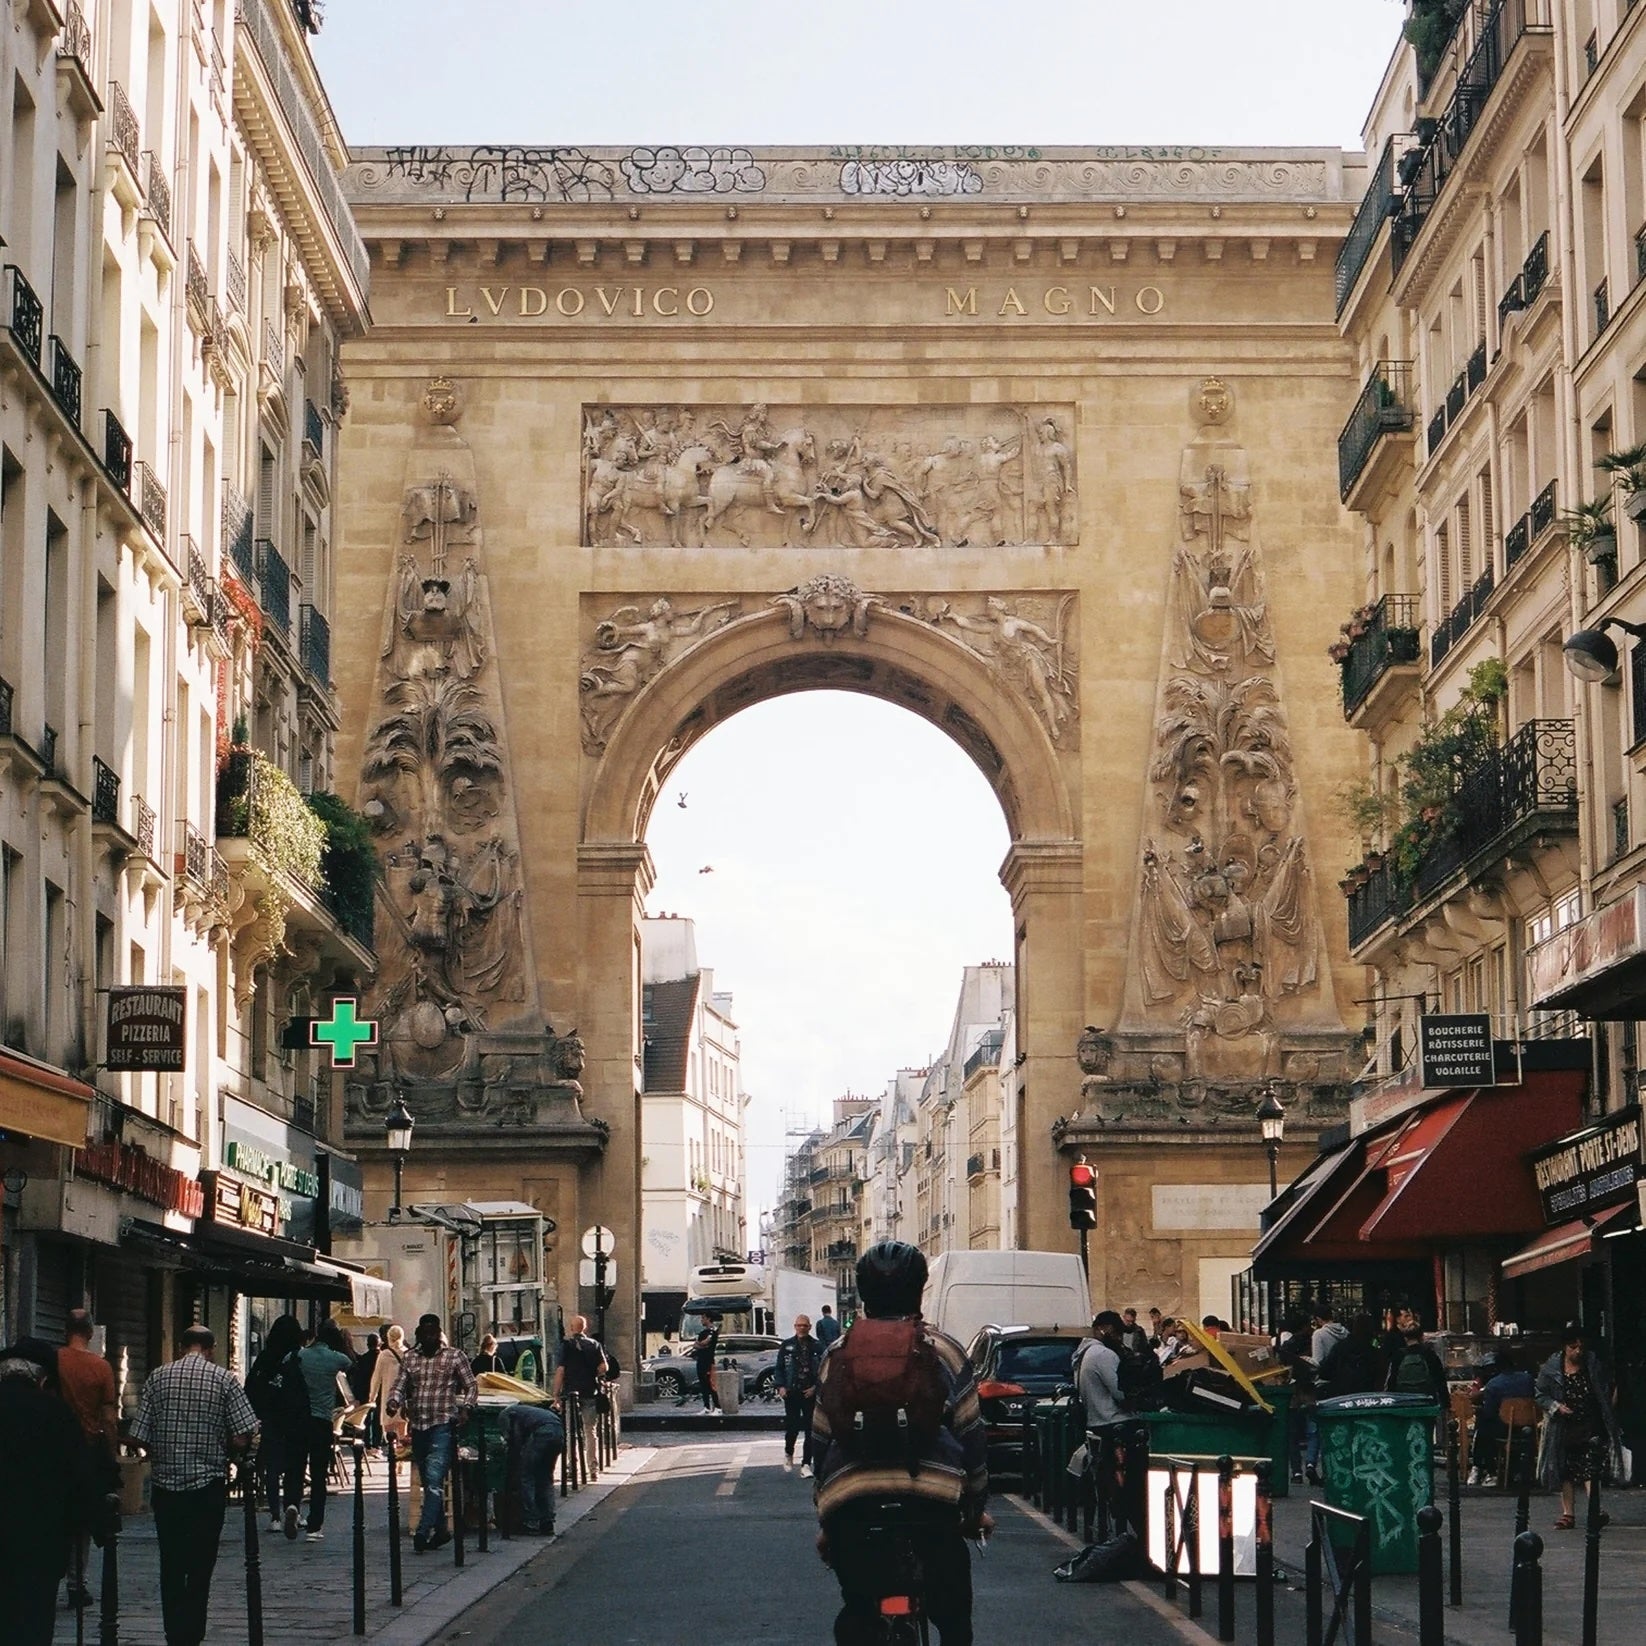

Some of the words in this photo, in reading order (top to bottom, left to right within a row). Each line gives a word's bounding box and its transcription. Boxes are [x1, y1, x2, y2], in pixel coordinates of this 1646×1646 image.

[446, 287, 714, 316] LVDOVICO
[945, 286, 1165, 315] MAGNO
[112, 994, 183, 1024] RESTAURANT
[121, 1025, 171, 1042] PIZZERIA
[1428, 1026, 1484, 1036] BOUCHERIE
[111, 1048, 133, 1063] SELF
[142, 1049, 182, 1064] SERVICE
[1424, 1052, 1491, 1062] CHARCUTERIE
[1435, 1066, 1481, 1076] VOLAILLE
